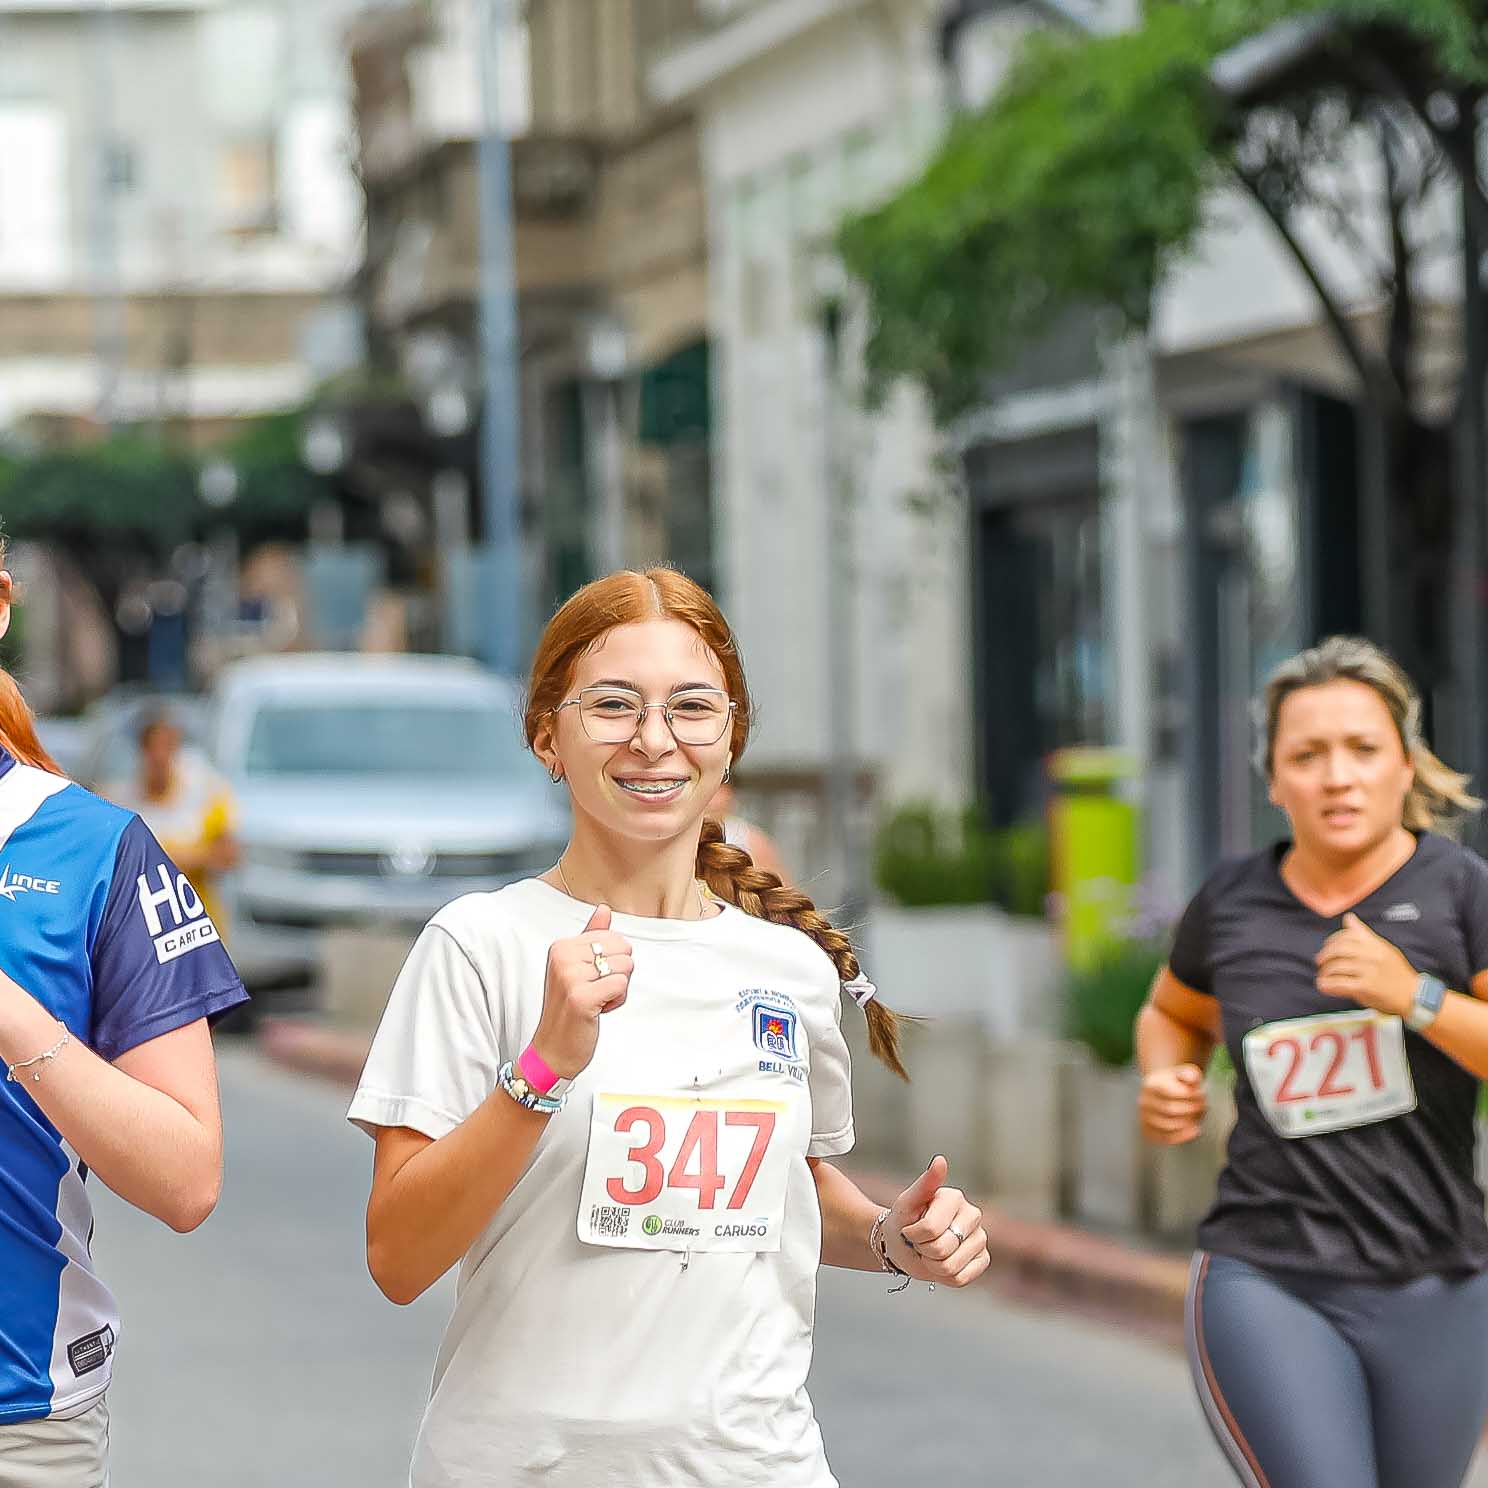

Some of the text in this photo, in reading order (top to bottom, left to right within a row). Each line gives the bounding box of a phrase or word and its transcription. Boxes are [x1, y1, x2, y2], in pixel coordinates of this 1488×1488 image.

[759, 1060, 785, 1074] BELL
[1266, 1023, 1385, 1105] 221
[606, 1106, 776, 1210] 347
[664, 1218, 685, 1227] CLUB
[714, 1224, 768, 1237] CARUSO
